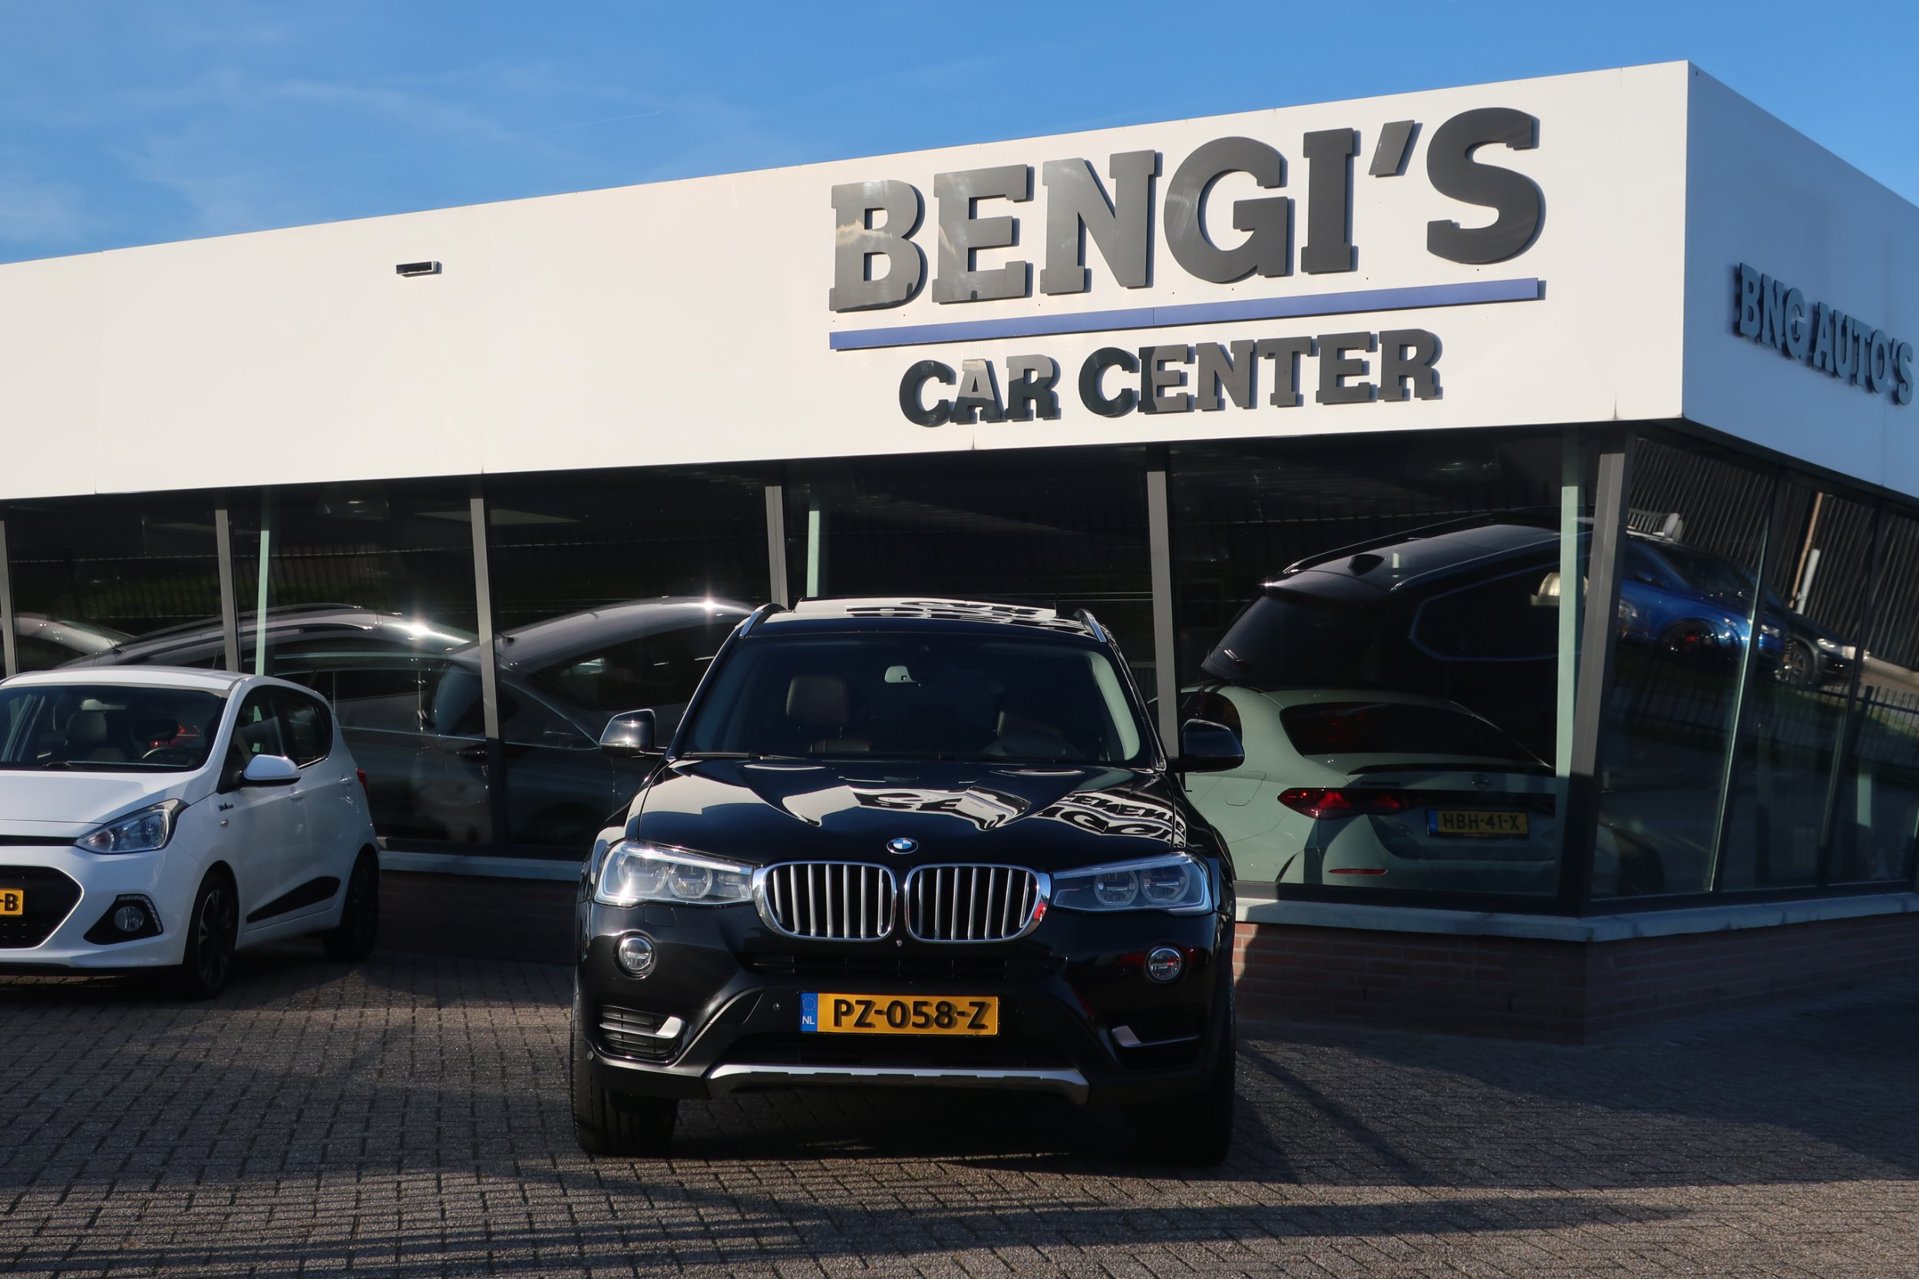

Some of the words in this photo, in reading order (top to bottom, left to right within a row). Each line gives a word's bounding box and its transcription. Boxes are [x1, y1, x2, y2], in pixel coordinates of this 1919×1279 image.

[830, 107, 1543, 312] BENGI'S
[1735, 262, 1808, 360] BNG
[1813, 301, 1914, 406] AUTO'S
[900, 353, 1060, 427] CAR
[1079, 328, 1443, 418] CENTER
[1443, 813, 1520, 830] HBH-41-X
[802, 1015, 815, 1025] NL
[833, 998, 992, 1030] PZ-058-Z
